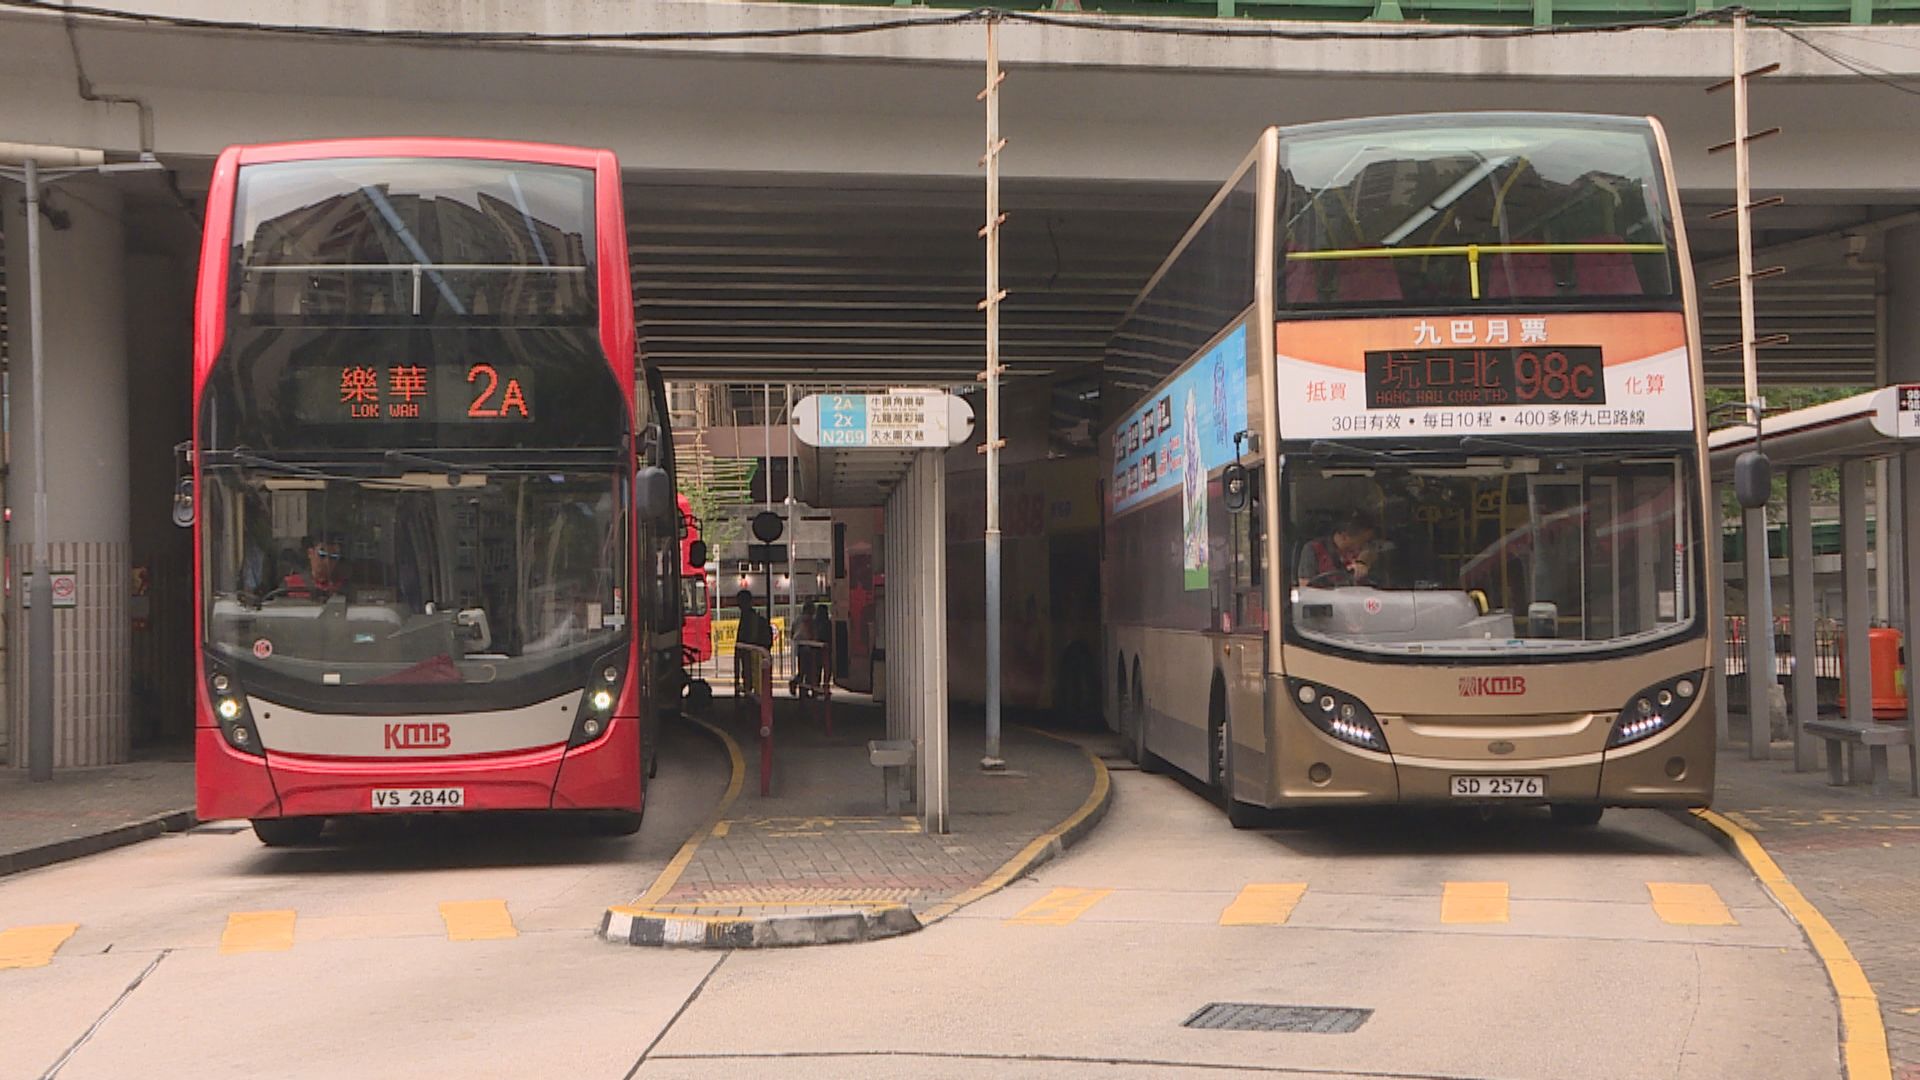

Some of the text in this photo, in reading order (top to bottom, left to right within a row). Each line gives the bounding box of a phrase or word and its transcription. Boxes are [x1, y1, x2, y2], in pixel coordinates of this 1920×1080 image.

[1413, 318, 1548, 345] 九巴月票
[1380, 351, 1501, 389] 坑口北
[340, 363, 528, 417] 樂華 2A
[1306, 380, 1347, 403] 抵買
[1624, 374, 1665, 395] 化算
[1375, 390, 1412, 405] HANG
[352, 404, 419, 417] LOK WAH
[1332, 408, 1646, 431] 30日有效 每日10程 400多條九巴路線
[823, 430, 865, 444] N269
[1478, 676, 1527, 696] KMB
[384, 723, 452, 750] KMB
[1457, 778, 1538, 794] SD 2576
[376, 790, 460, 806] VS 2840
